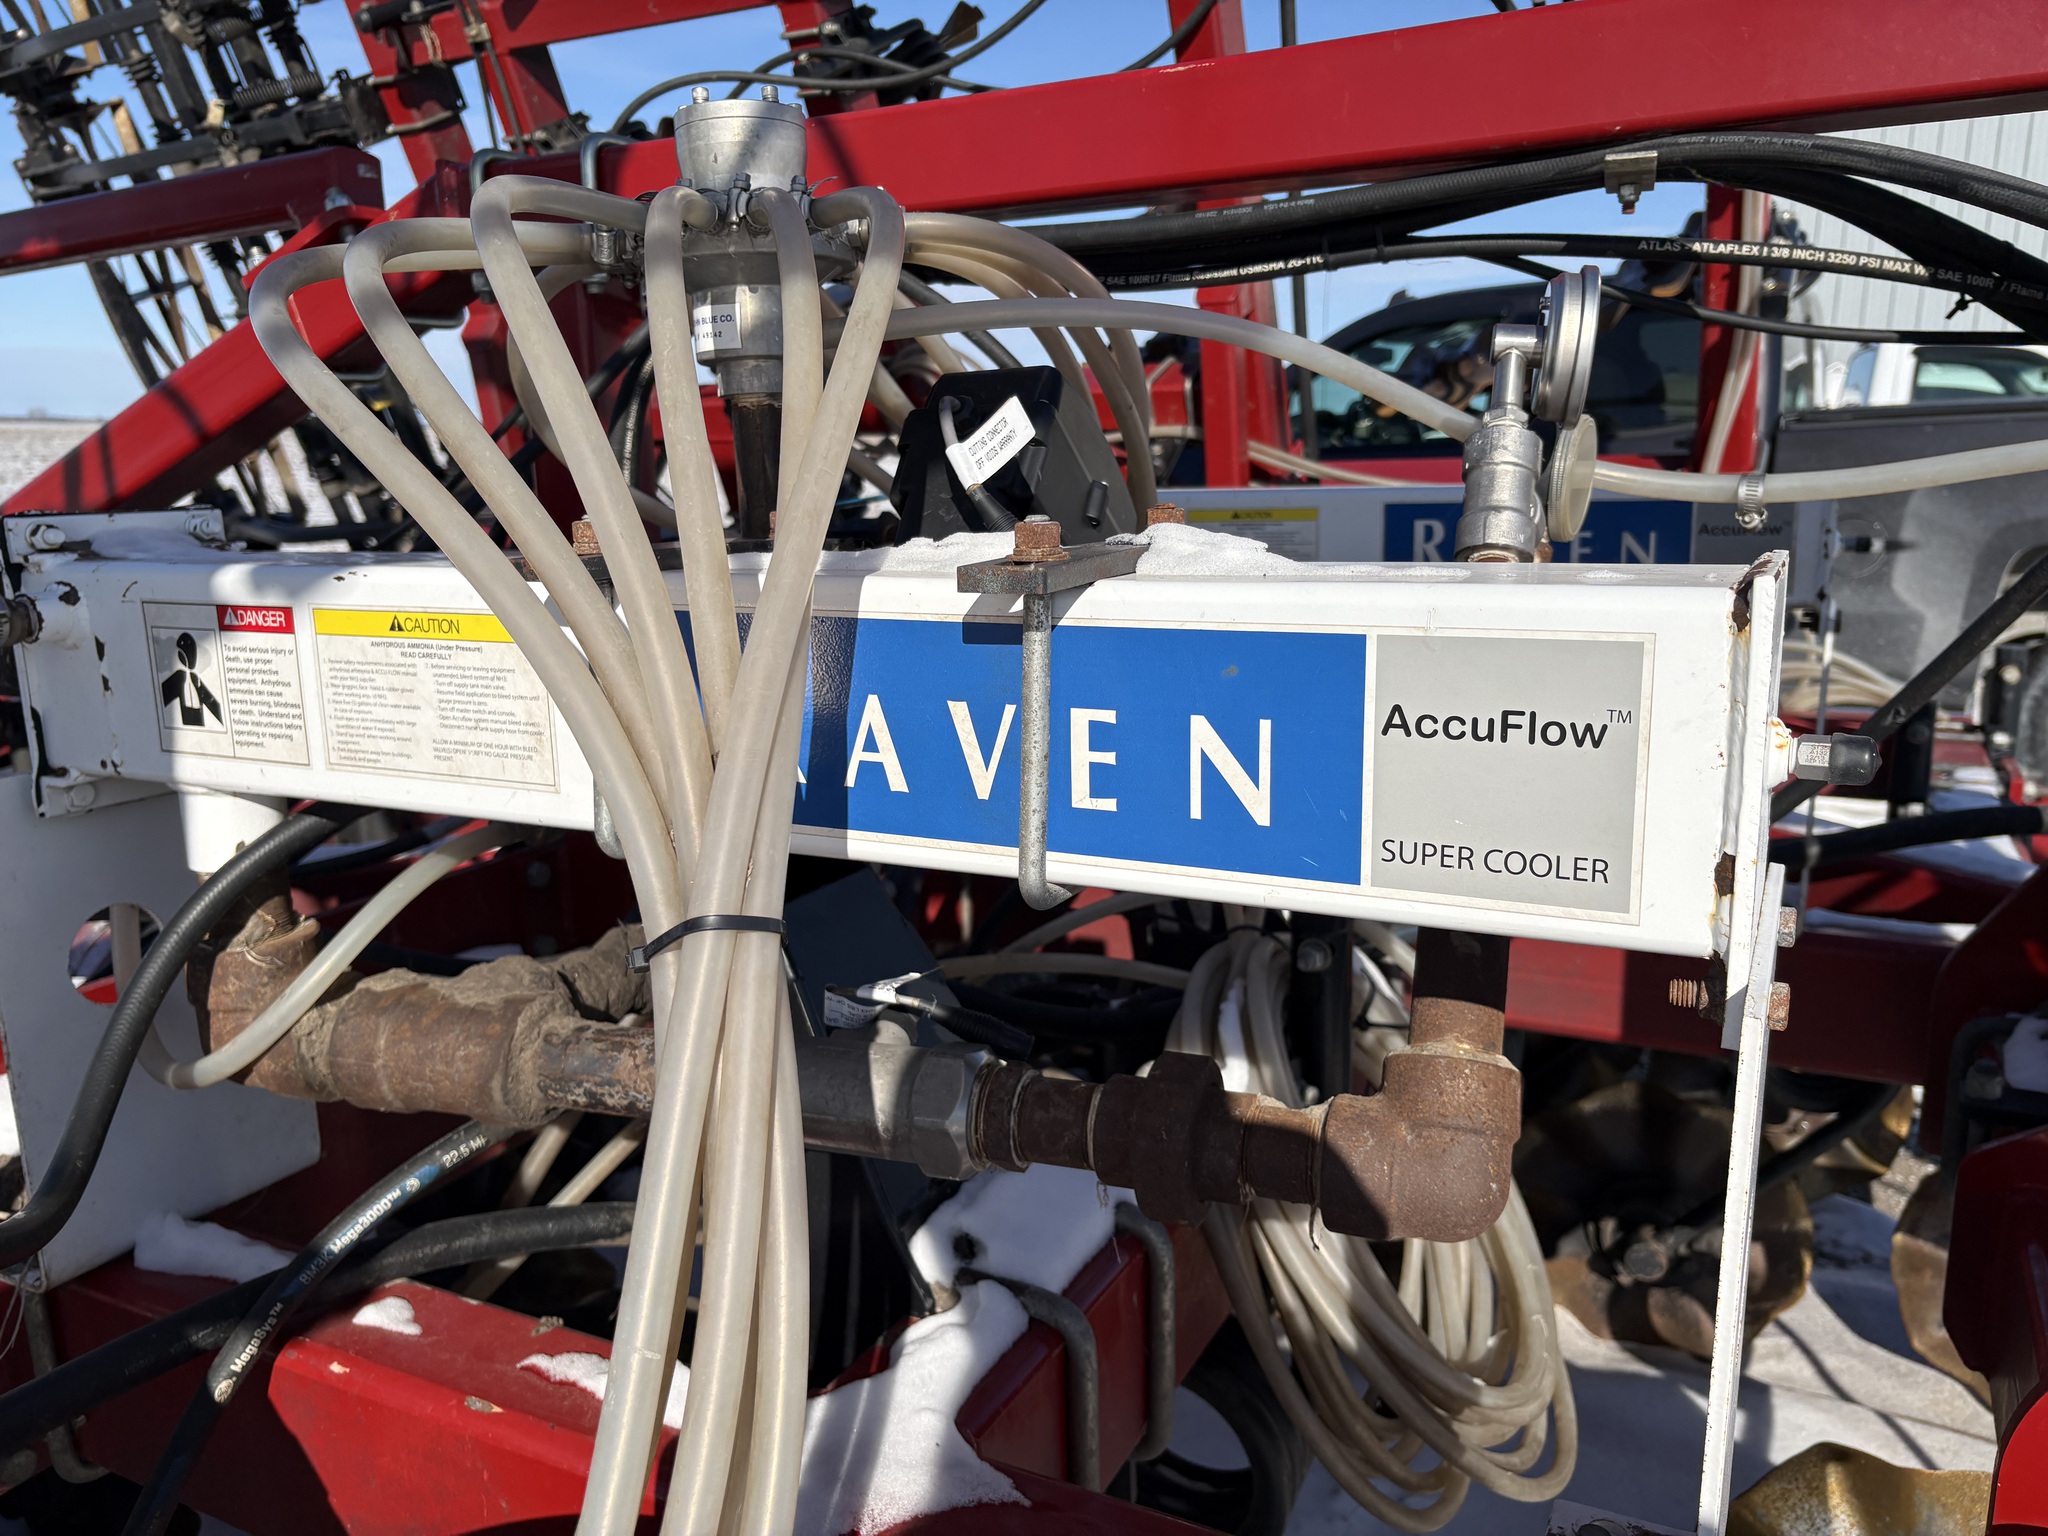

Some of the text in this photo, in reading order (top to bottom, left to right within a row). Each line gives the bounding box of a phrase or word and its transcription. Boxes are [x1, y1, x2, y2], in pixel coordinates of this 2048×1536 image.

[1638, 240, 1681, 250] ATLAS
[1692, 242, 1760, 256] ATLAFLEX
[1771, 246, 1790, 259] 3/8
[1792, 248, 1824, 261] INCH
[1827, 252, 1857, 265] 3250
[1858, 255, 1880, 269] PSI
[1882, 259, 1912, 274] MAX
[1936, 268, 1963, 283] SAE
[2010, 283, 2044, 300] Flame
[1106, 276, 1126, 286] SAE
[701, 315, 718, 325] BLUE
[719, 314, 735, 323] CO.
[968, 436, 988, 457] CUTTING
[975, 457, 985, 470] OFF
[999, 428, 1018, 452] WARRANTY
[236, 609, 285, 626] DANGER
[403, 617, 460, 634] CAUTION
[370, 640, 482, 653] ANHYDROUS AMMONIA (Under Pressure)
[417, 652, 452, 660] CAREFULLY
[796, 694, 1271, 827] AVEN
[1381, 839, 1609, 884] SUPER COOLER
[442, 1144, 470, 1168] 22.5
